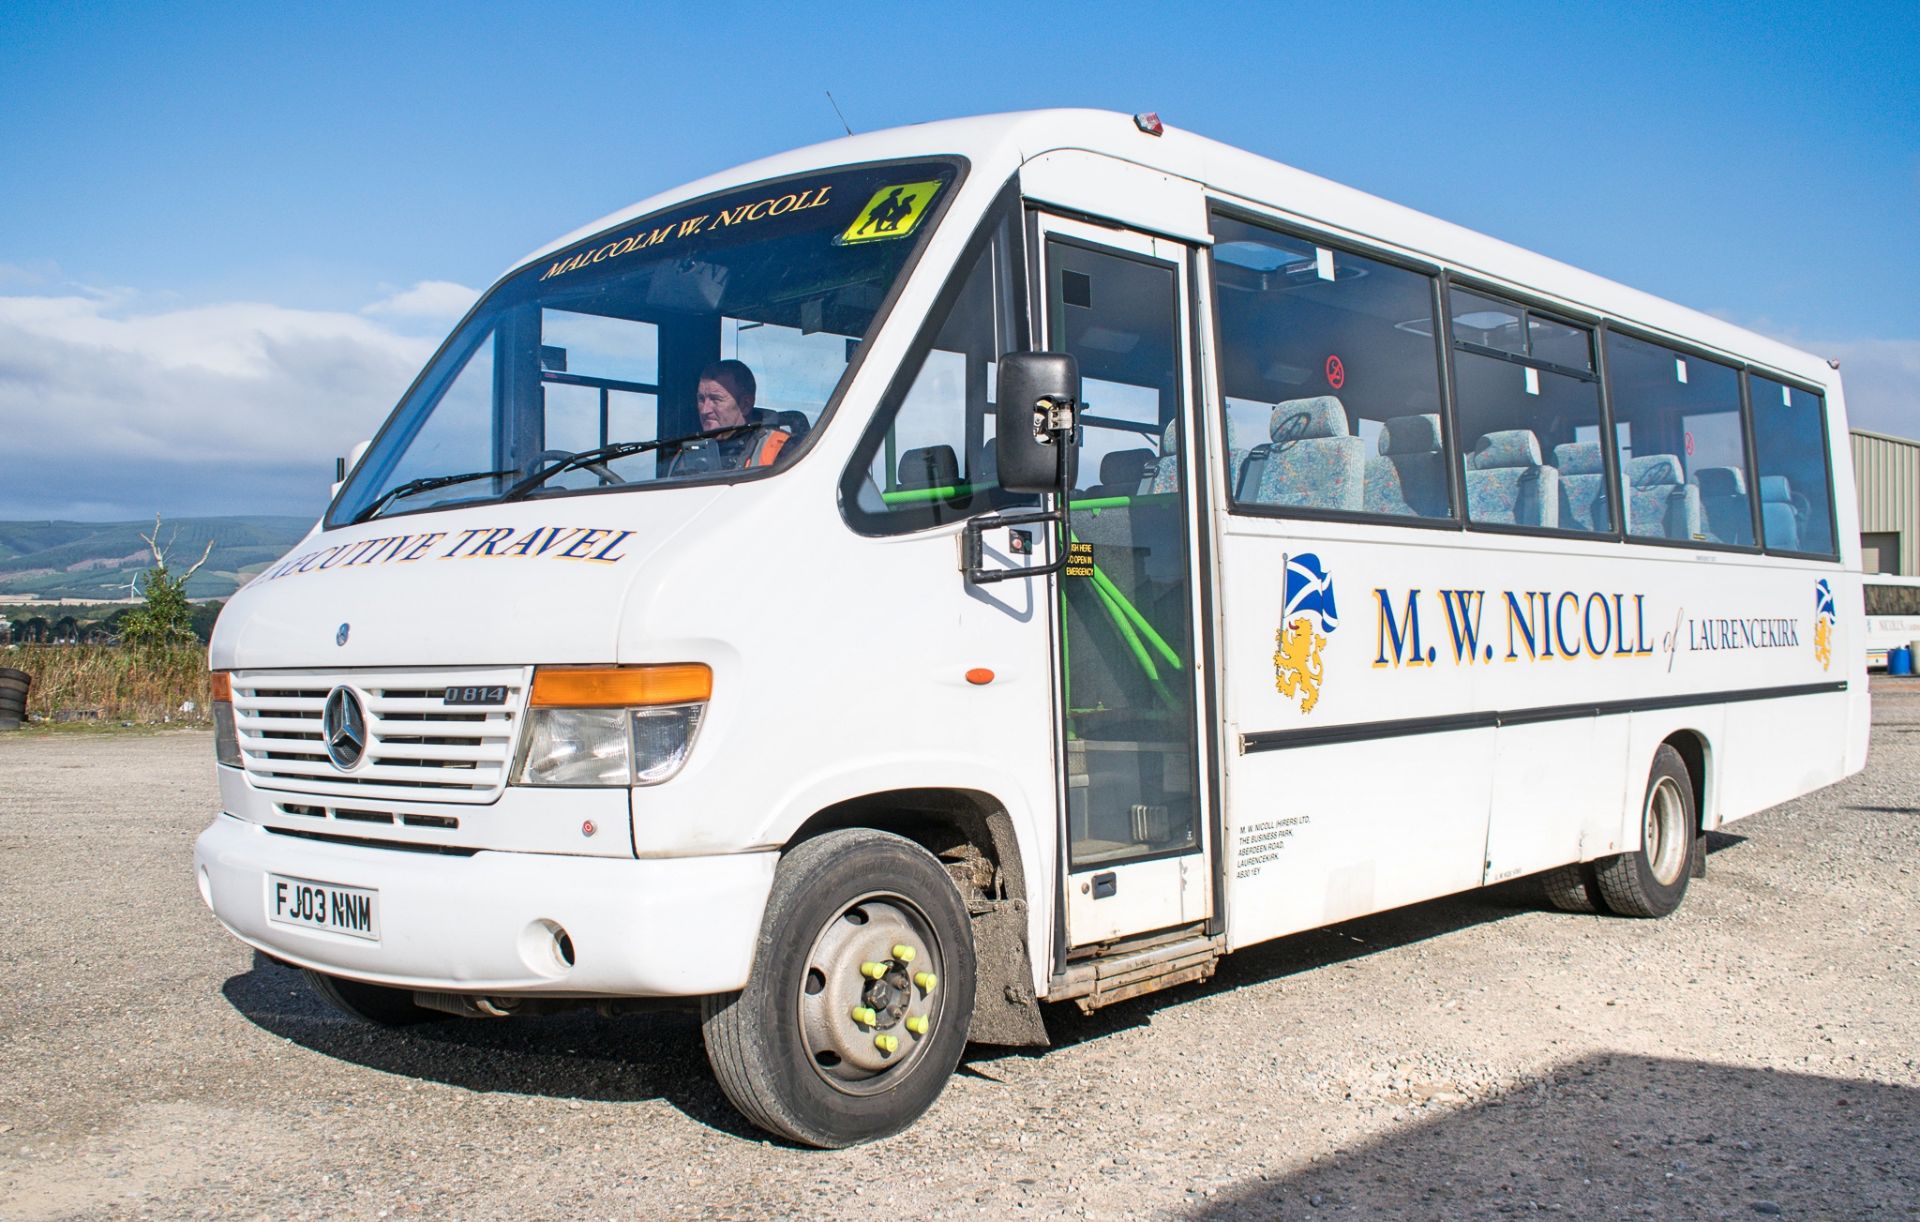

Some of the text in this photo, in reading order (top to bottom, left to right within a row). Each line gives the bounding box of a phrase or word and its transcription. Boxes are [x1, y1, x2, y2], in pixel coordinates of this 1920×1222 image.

[539, 186, 832, 282] MALCOLM W. NICOLL
[437, 526, 638, 566] TRAVEL
[1372, 588, 1799, 673] M. W. NICOLL of LAURENCEKIRK
[463, 687, 504, 702] 814
[1239, 836, 1250, 845] THE
[1251, 831, 1278, 843] BUSINESS
[1254, 822, 1274, 831] NICOLL
[1238, 844, 1267, 856] ABERDEEN
[276, 882, 371, 932] FJ03 NNM
